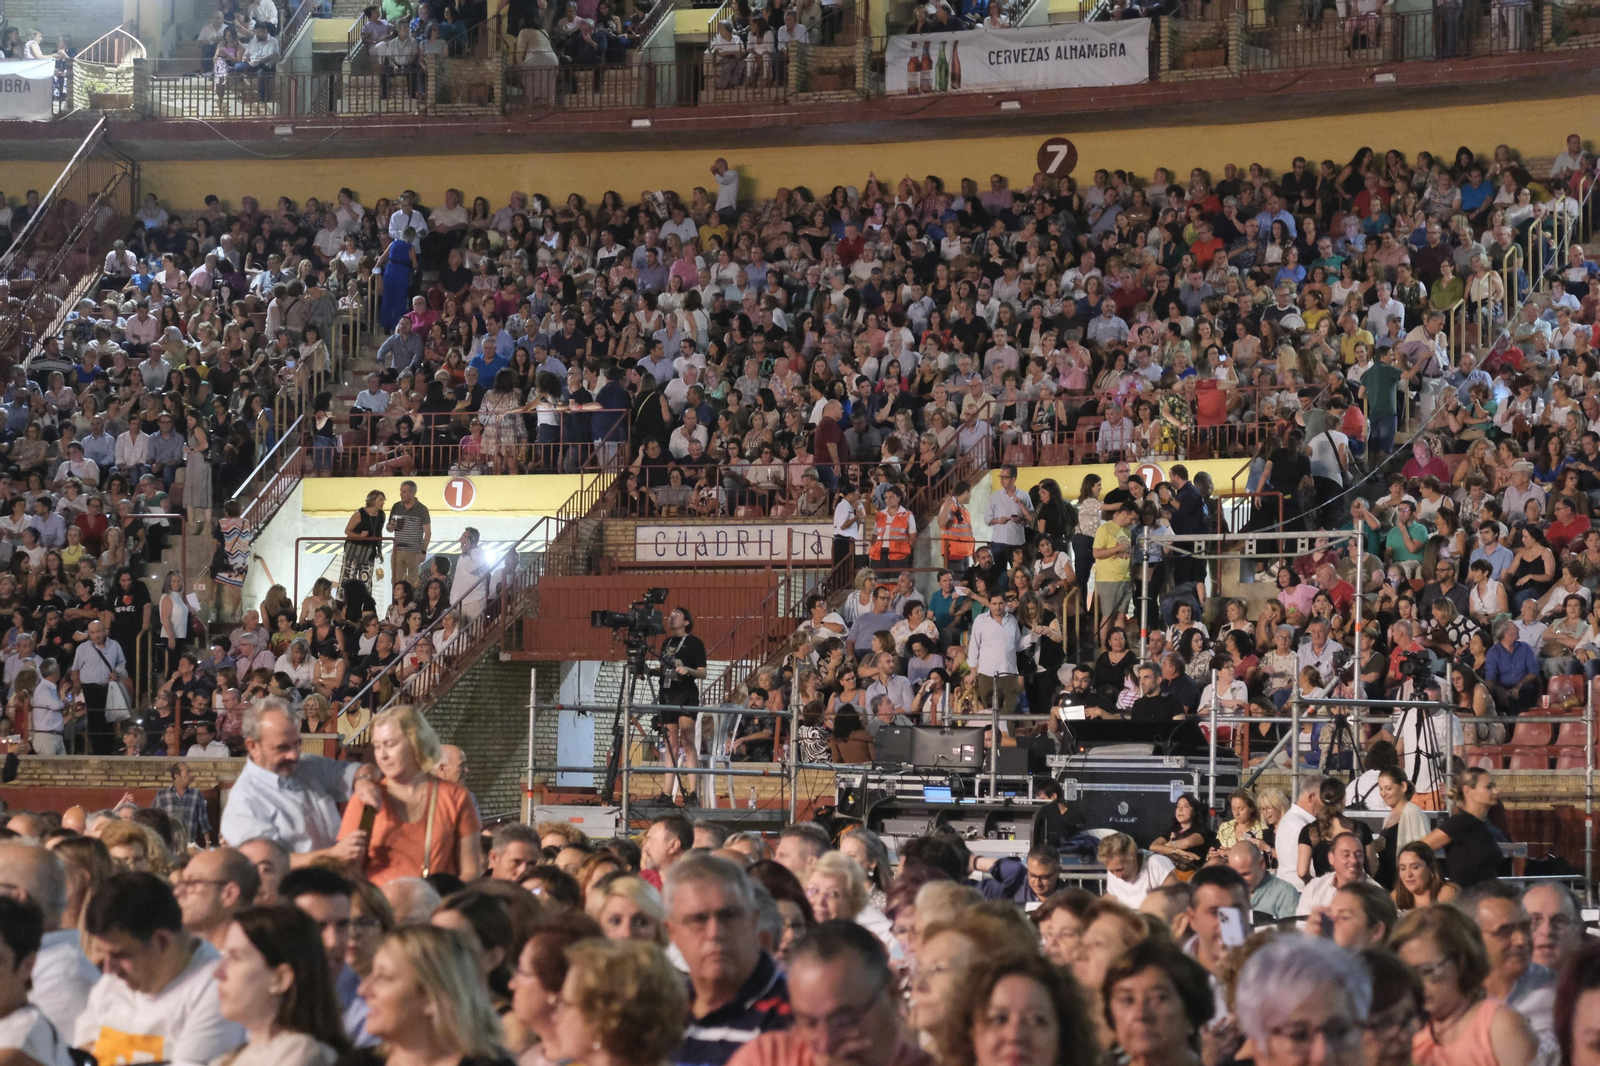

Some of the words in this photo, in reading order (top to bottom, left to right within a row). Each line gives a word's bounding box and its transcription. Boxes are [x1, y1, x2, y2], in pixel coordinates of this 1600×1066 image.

[988, 46, 1050, 66] CERVEZAS
[1055, 42, 1126, 61] ALHAMBRA
[1046, 144, 1068, 174] 7
